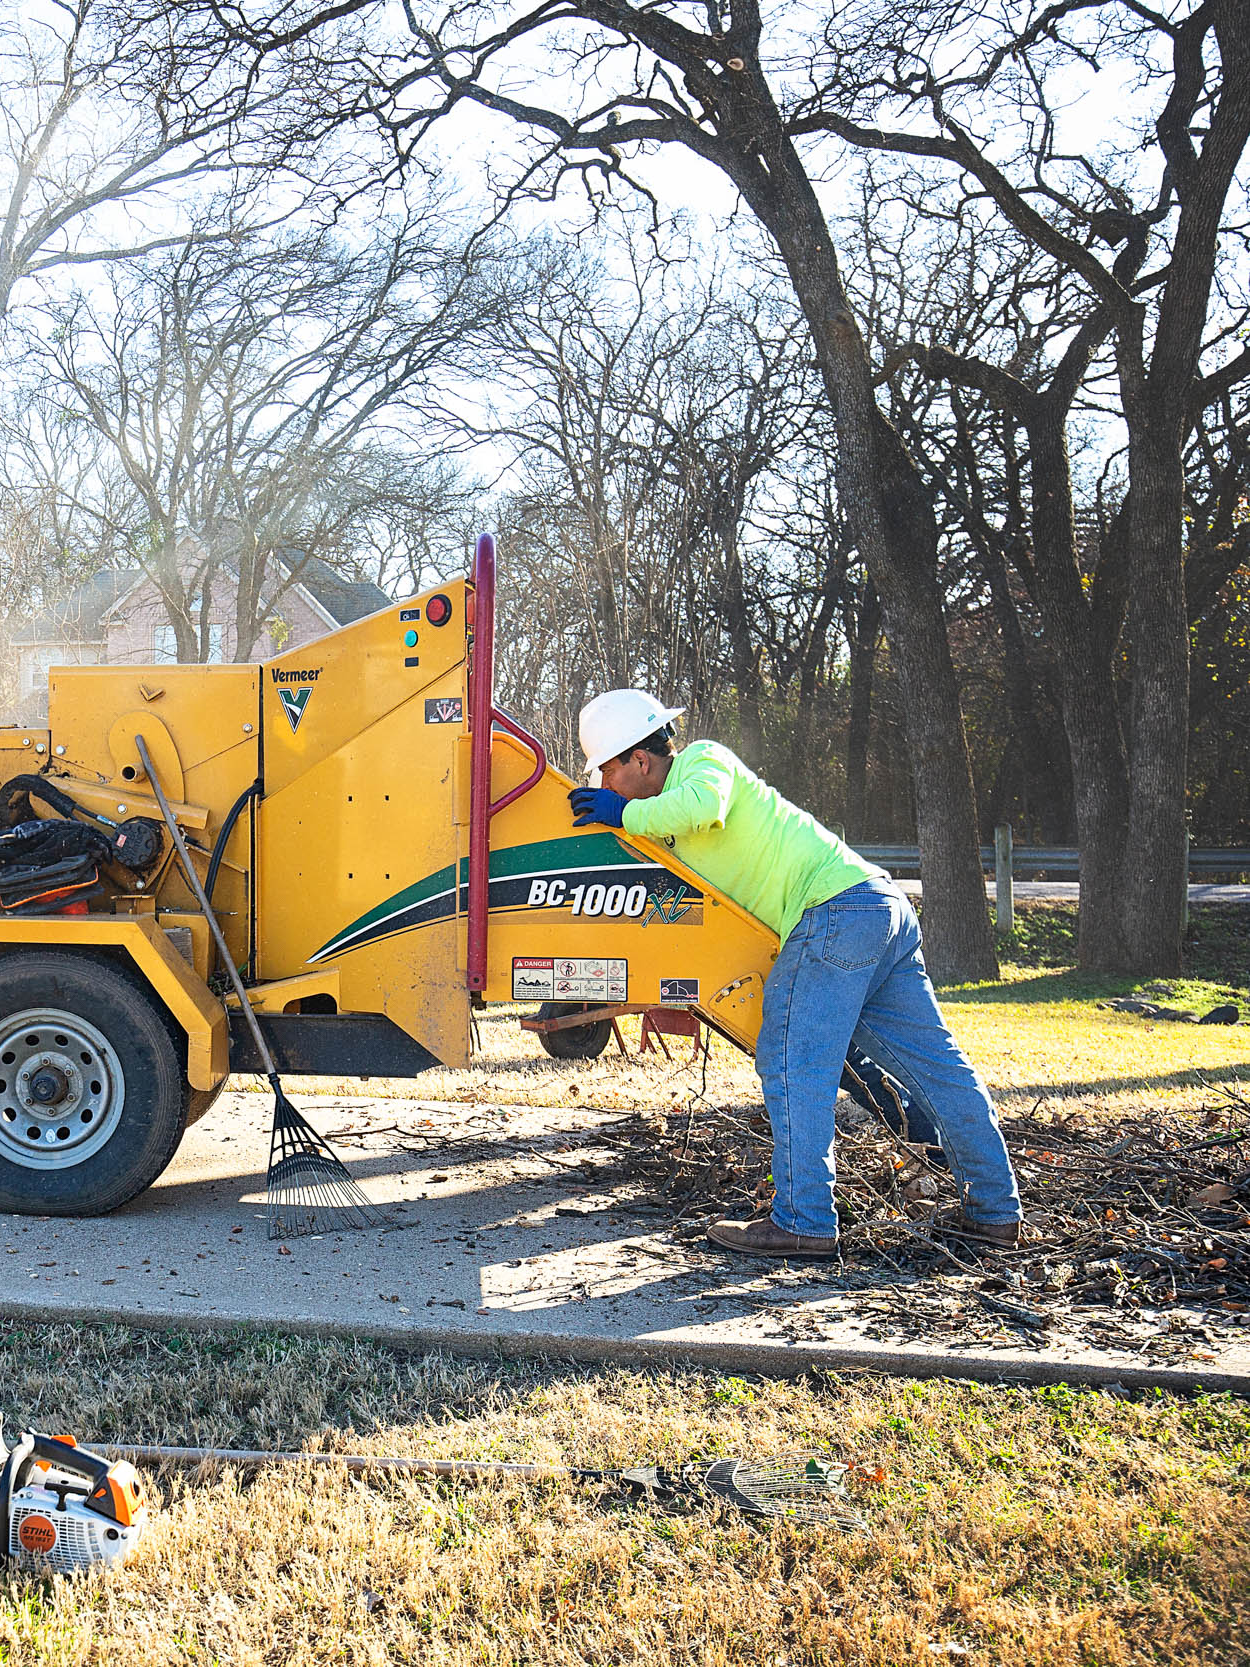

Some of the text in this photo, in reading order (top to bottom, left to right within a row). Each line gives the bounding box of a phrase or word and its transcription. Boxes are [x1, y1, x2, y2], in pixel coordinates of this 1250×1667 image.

[271, 667, 321, 683] Vermeer
[641, 885, 693, 929] XL
[524, 960, 552, 968] DANGER
[22, 1526, 53, 1537] STIHL
